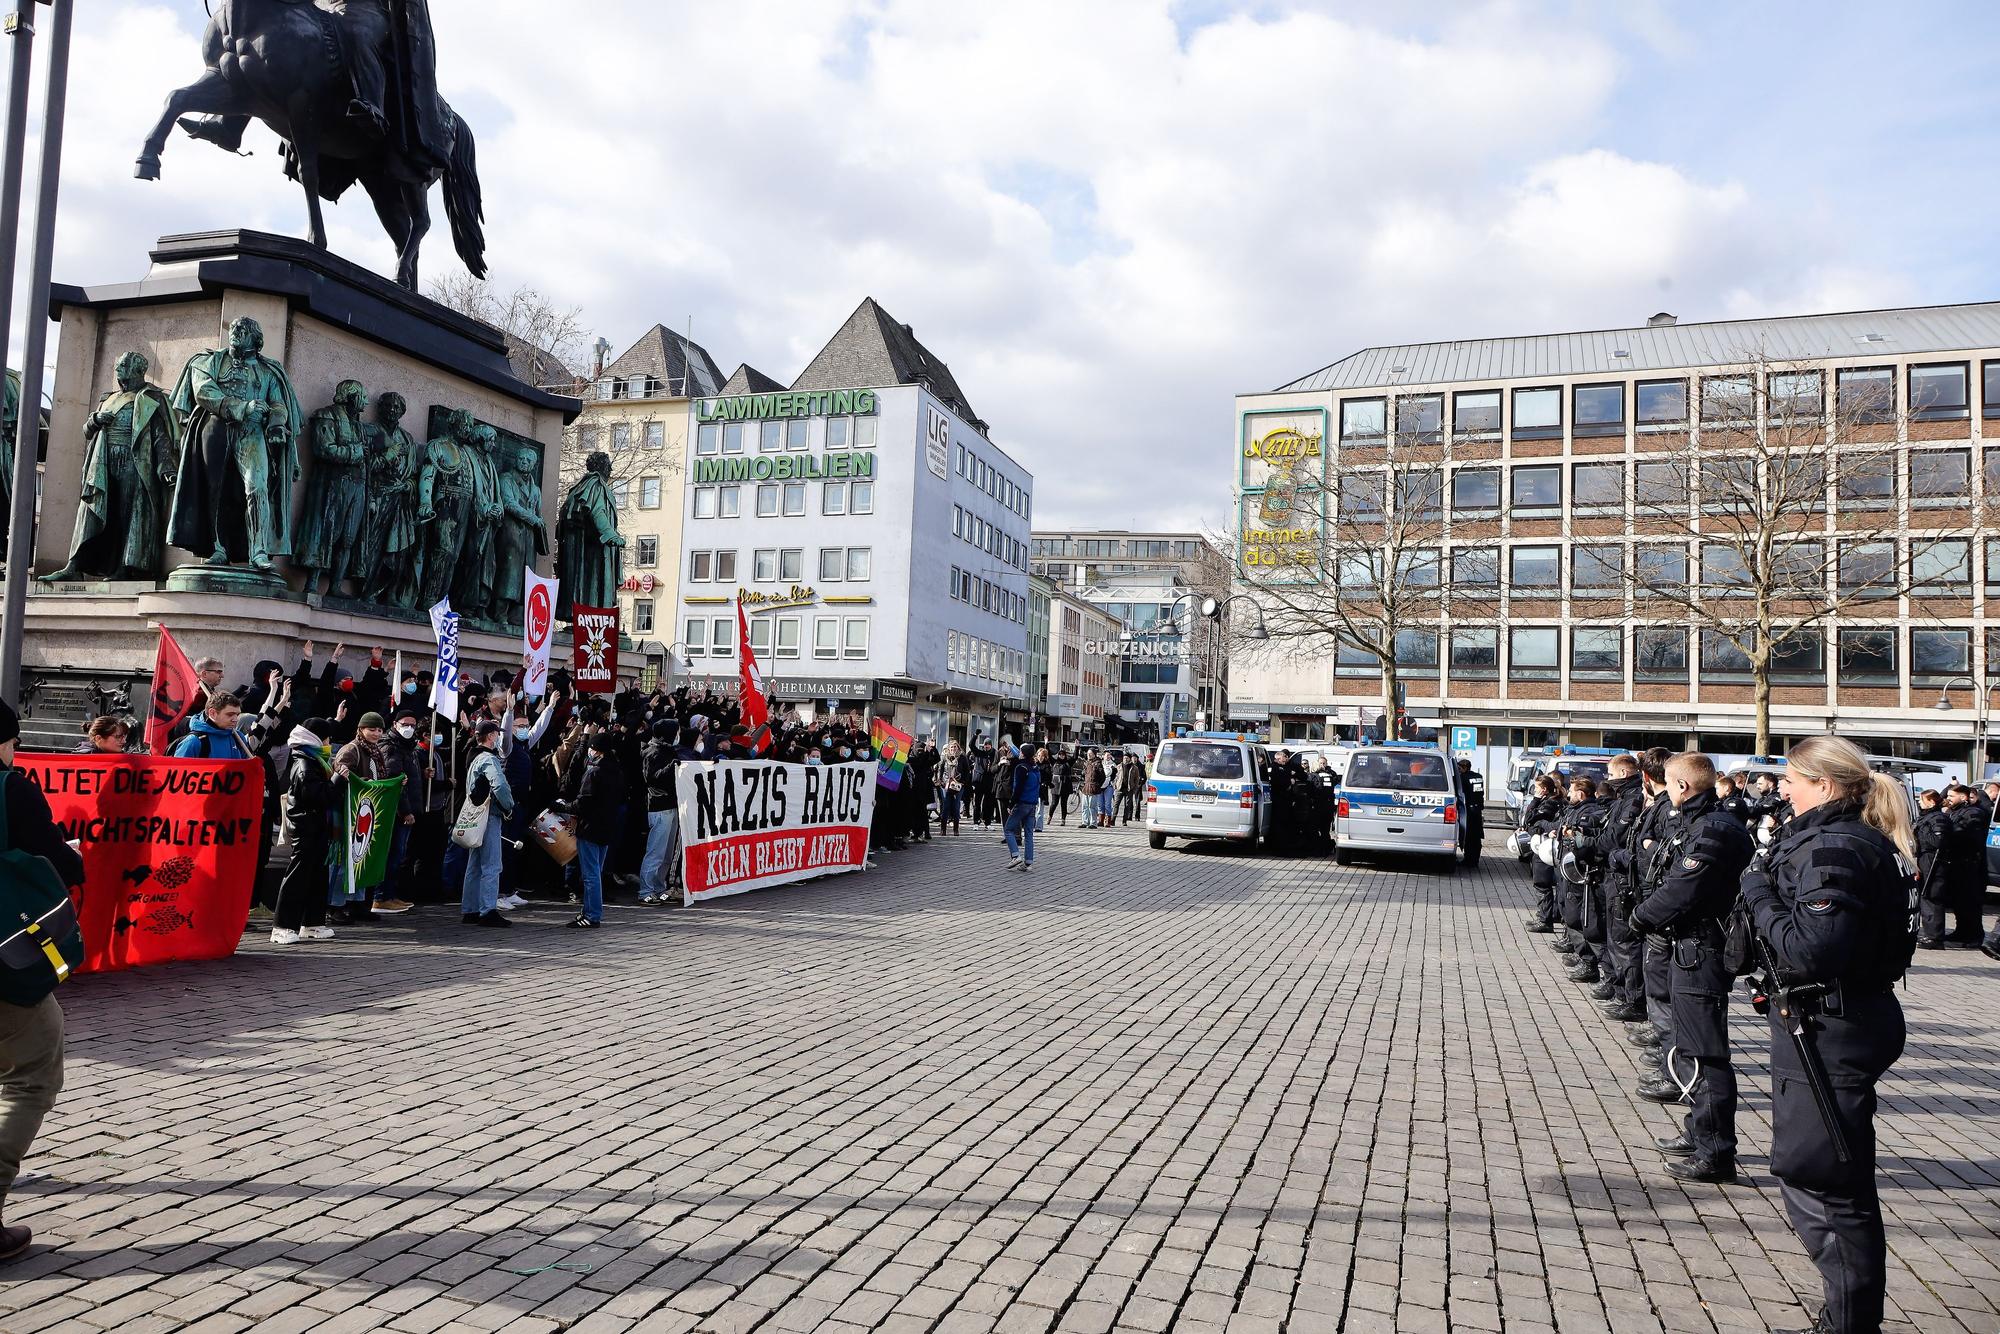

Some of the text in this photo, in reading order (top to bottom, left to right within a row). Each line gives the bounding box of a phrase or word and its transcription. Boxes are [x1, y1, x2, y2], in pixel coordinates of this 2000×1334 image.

[696, 389, 875, 422] LAMMERTING
[929, 409, 948, 448] LIG
[693, 452, 874, 483] IMMOBILIEN
[790, 584, 815, 600] Bit
[577, 614, 615, 628] ANTIFA
[781, 682, 851, 694] HEUMARKT
[882, 685, 914, 700] RESTAURANT
[1293, 706, 1330, 714] GEORG
[1457, 730, 1471, 748] P
[114, 768, 153, 794] DIE
[152, 769, 245, 795] JUGEND
[1203, 781, 1242, 794] POLIZEI
[694, 766, 866, 839] NAZIS RAUS
[1403, 795, 1445, 806] POLIZEI
[706, 834, 850, 886] KÖLN BLEIBT ANTIFA
